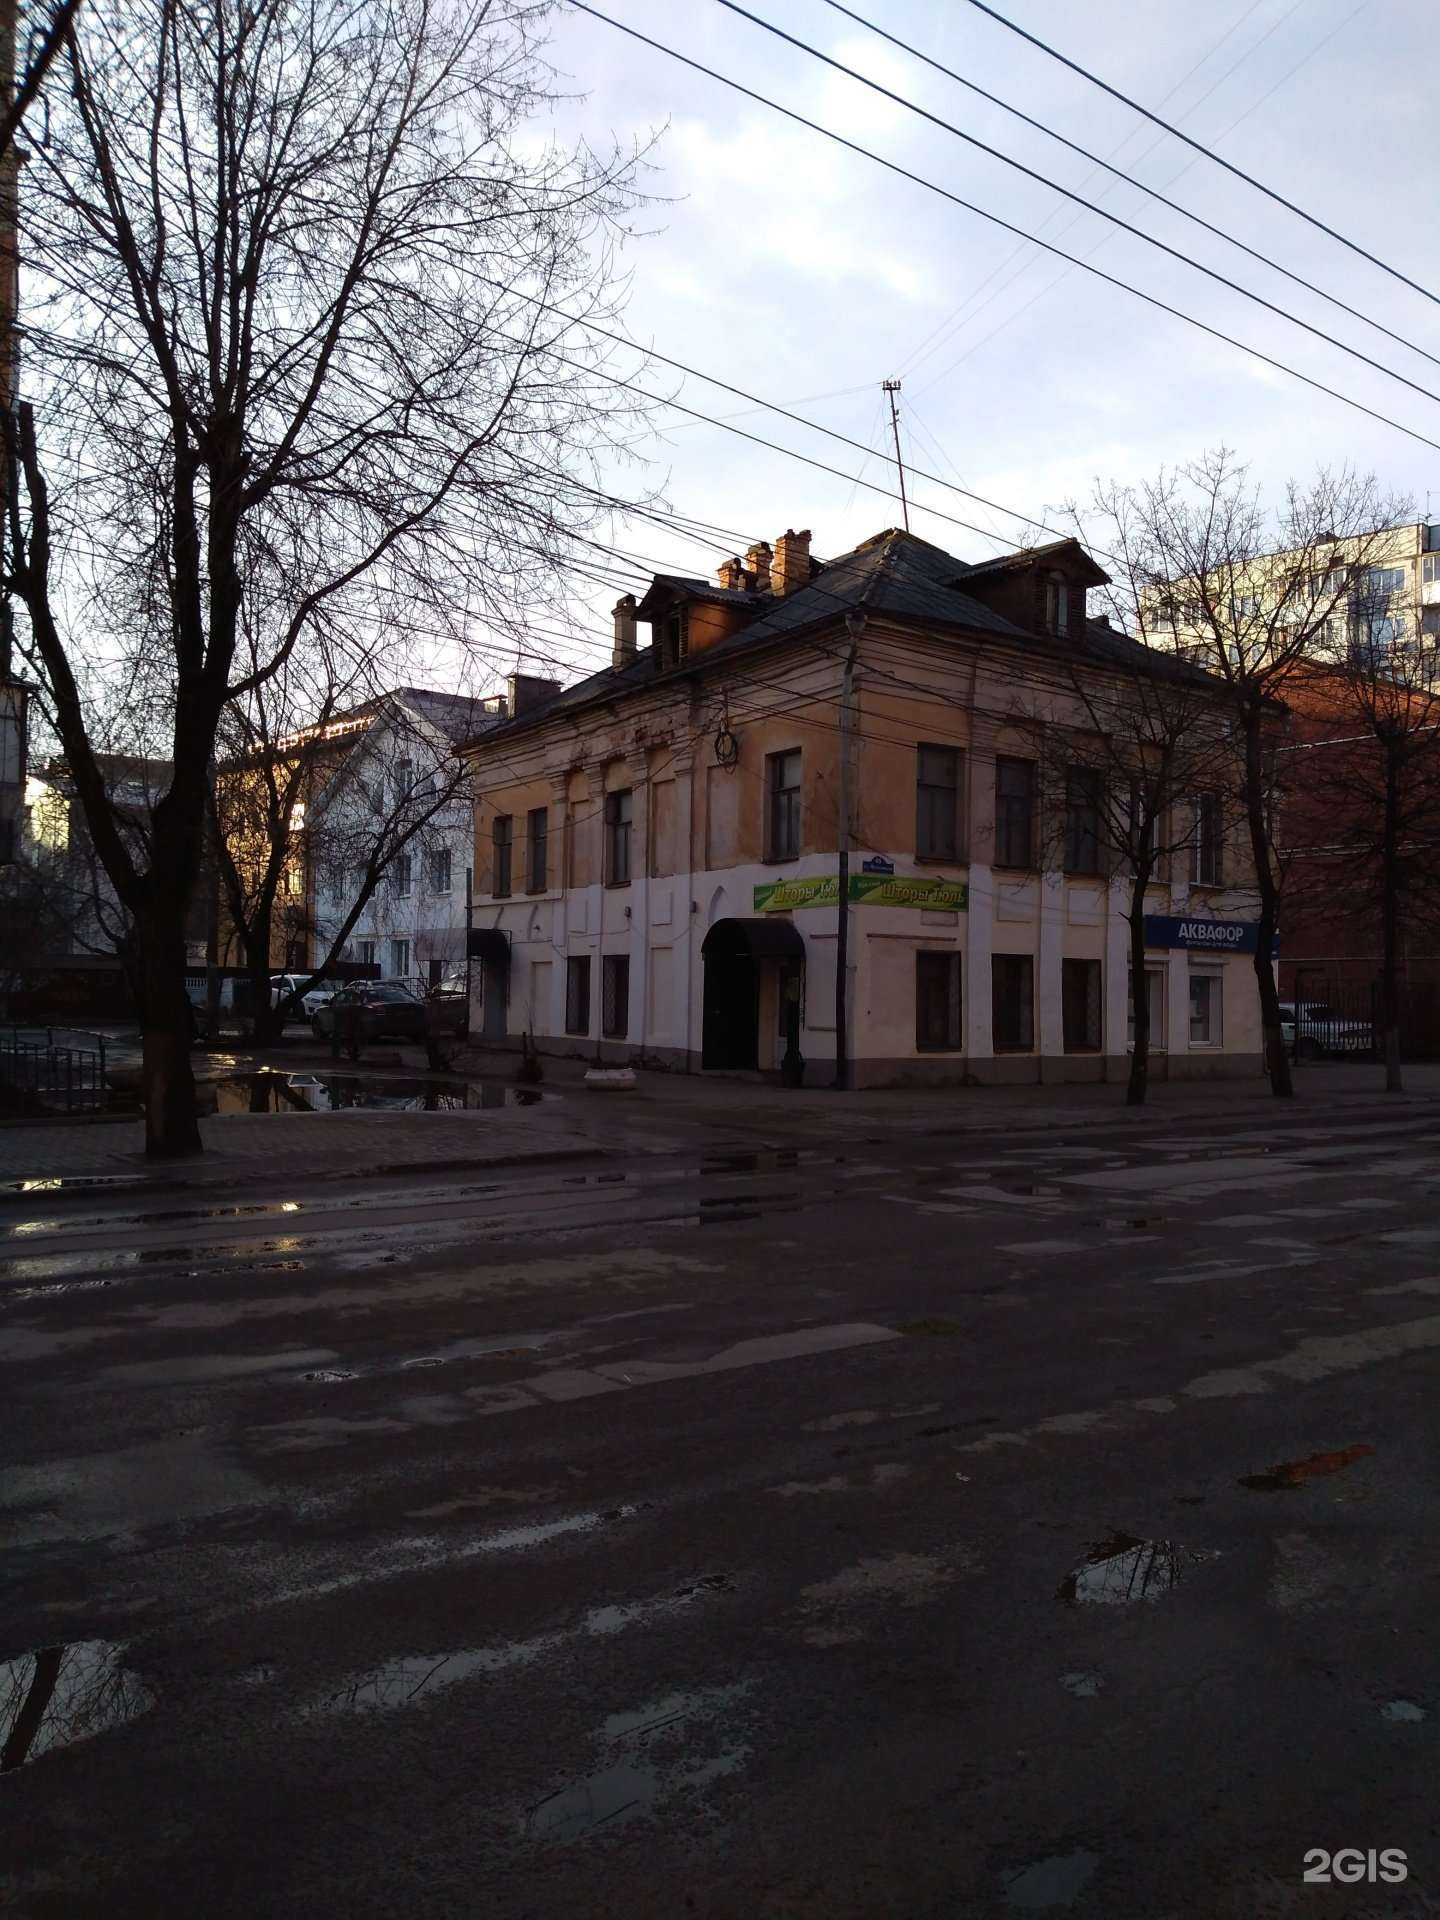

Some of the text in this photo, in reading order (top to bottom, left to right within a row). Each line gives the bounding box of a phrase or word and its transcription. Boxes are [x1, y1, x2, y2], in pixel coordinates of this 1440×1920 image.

[774, 884, 815, 902] Шторы
[881, 883, 929, 902] Шторы
[933, 887, 965, 903] Тюль
[1178, 922, 1244, 941] АКВАФОР
